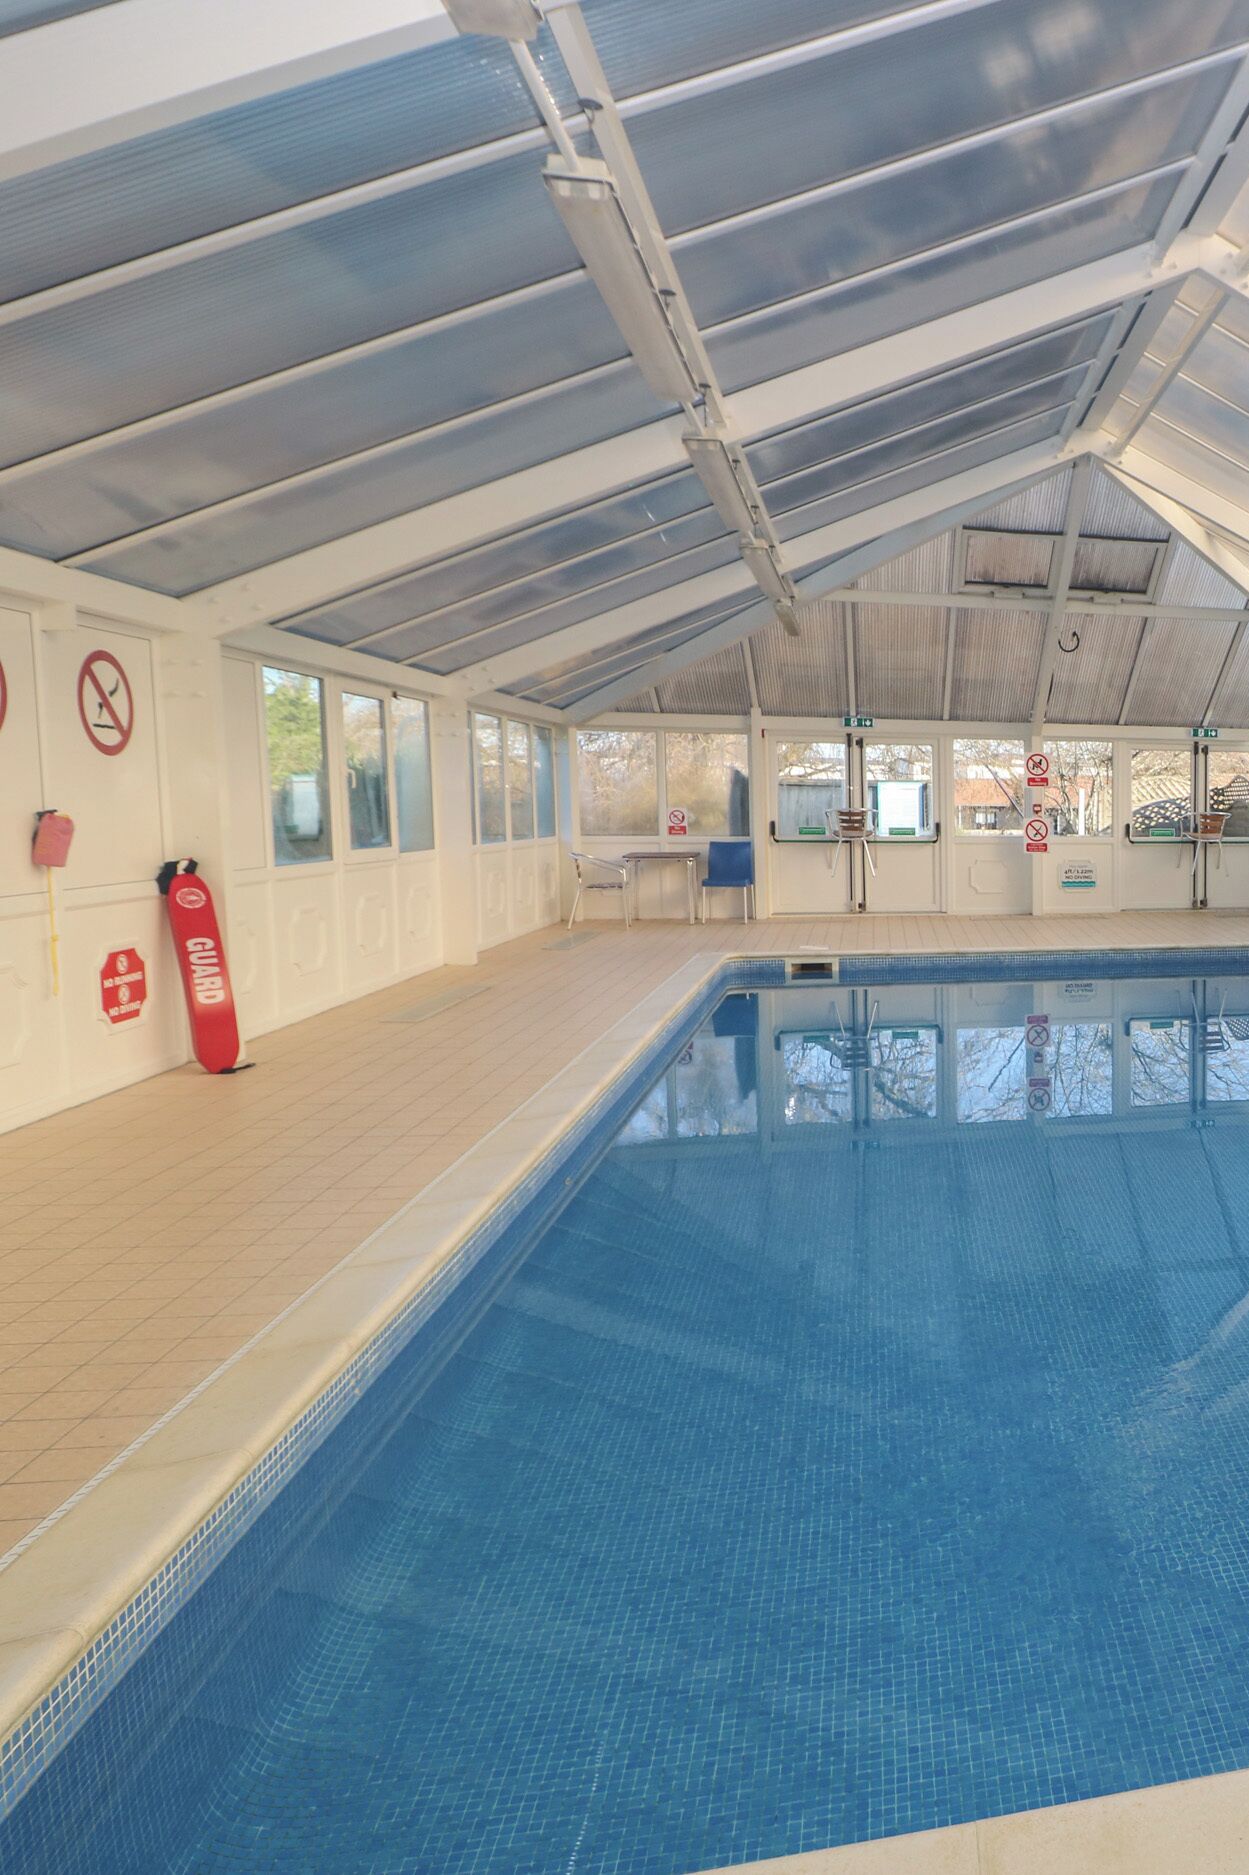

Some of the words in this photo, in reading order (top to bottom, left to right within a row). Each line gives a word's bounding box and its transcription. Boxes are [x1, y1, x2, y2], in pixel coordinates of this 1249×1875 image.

[186, 937, 226, 1004] GUARD
[103, 978, 113, 989] NO
[114, 971, 143, 986] RUNNING
[109, 1006, 120, 1017] NO
[120, 1000, 141, 1014] DIVING
